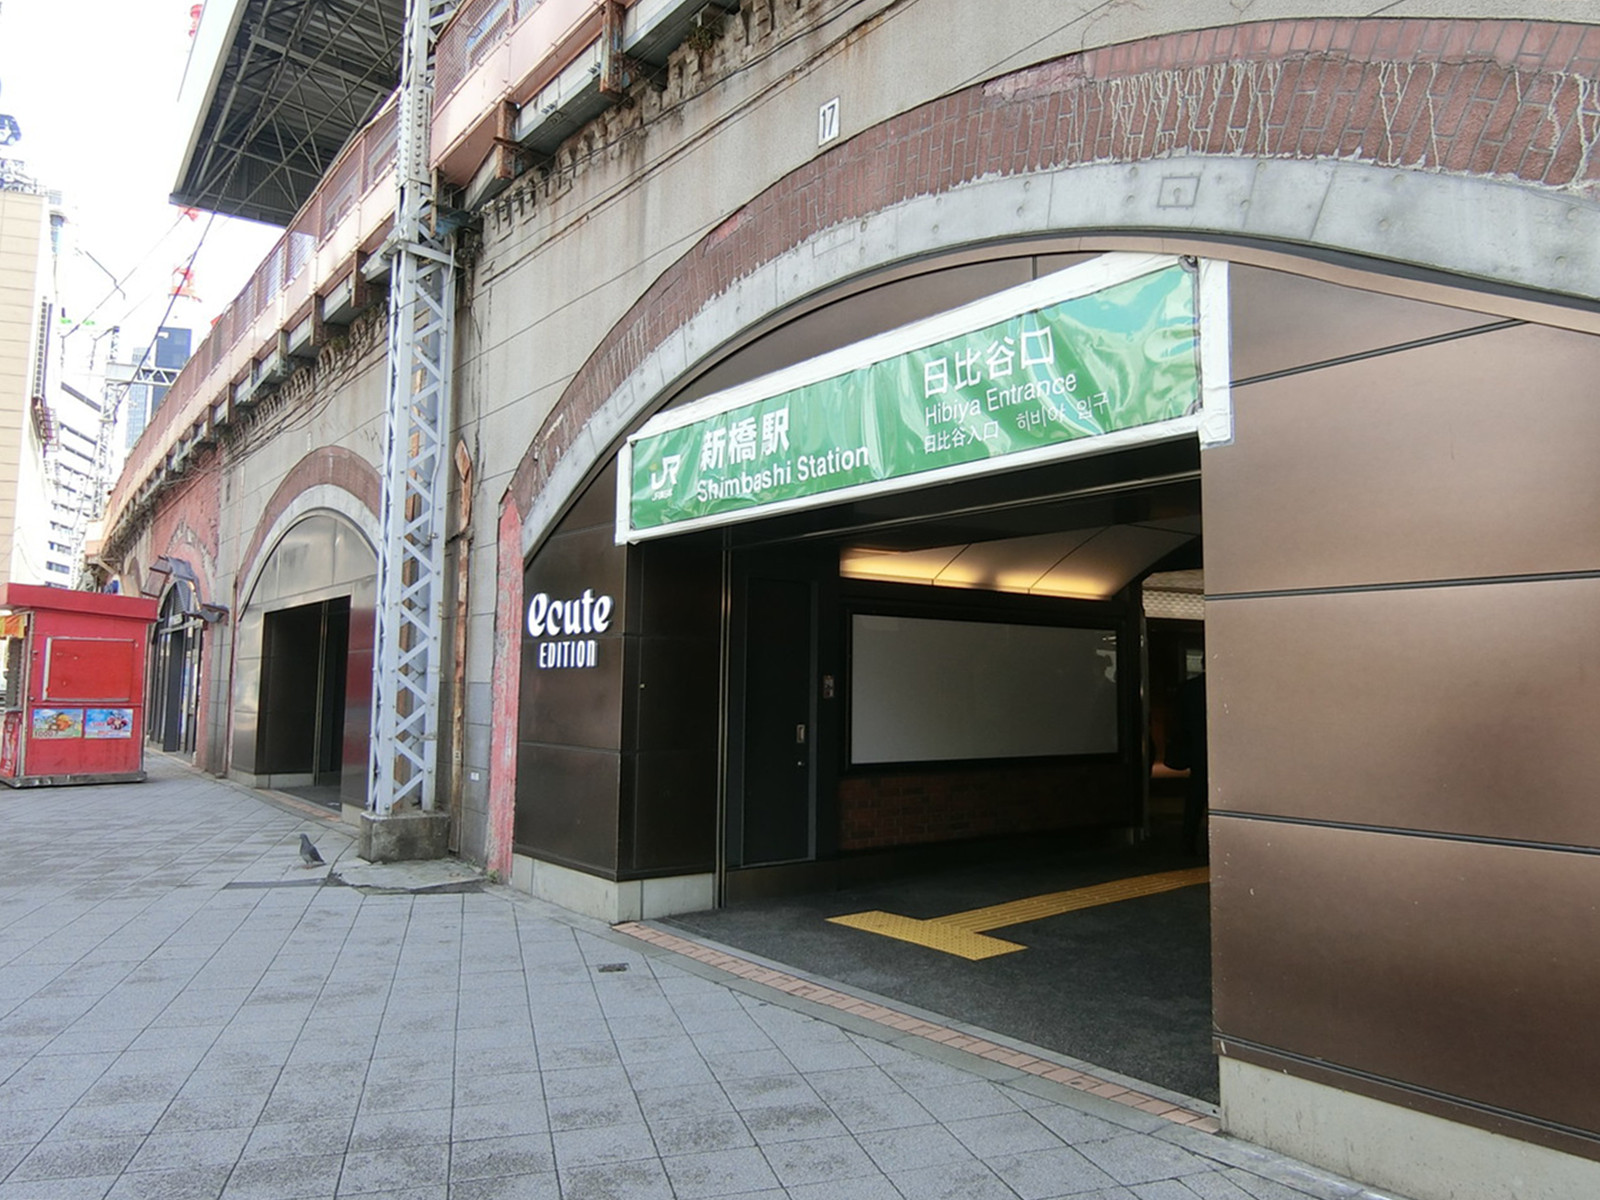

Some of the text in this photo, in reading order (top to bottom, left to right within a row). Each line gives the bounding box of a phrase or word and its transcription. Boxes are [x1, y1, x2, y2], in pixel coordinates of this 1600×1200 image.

[821, 103, 836, 139] 17
[924, 325, 1055, 398] 日比谷口
[924, 373, 1078, 427] Hibiya Entrance
[1076, 391, 1109, 421] 입구
[700, 407, 790, 472] 新橋駅
[924, 420, 999, 455] 日比谷入口
[651, 454, 681, 490] JR
[696, 446, 869, 503] Shimbashi Station
[527, 588, 613, 637] ecute
[539, 640, 598, 668] EDITION
